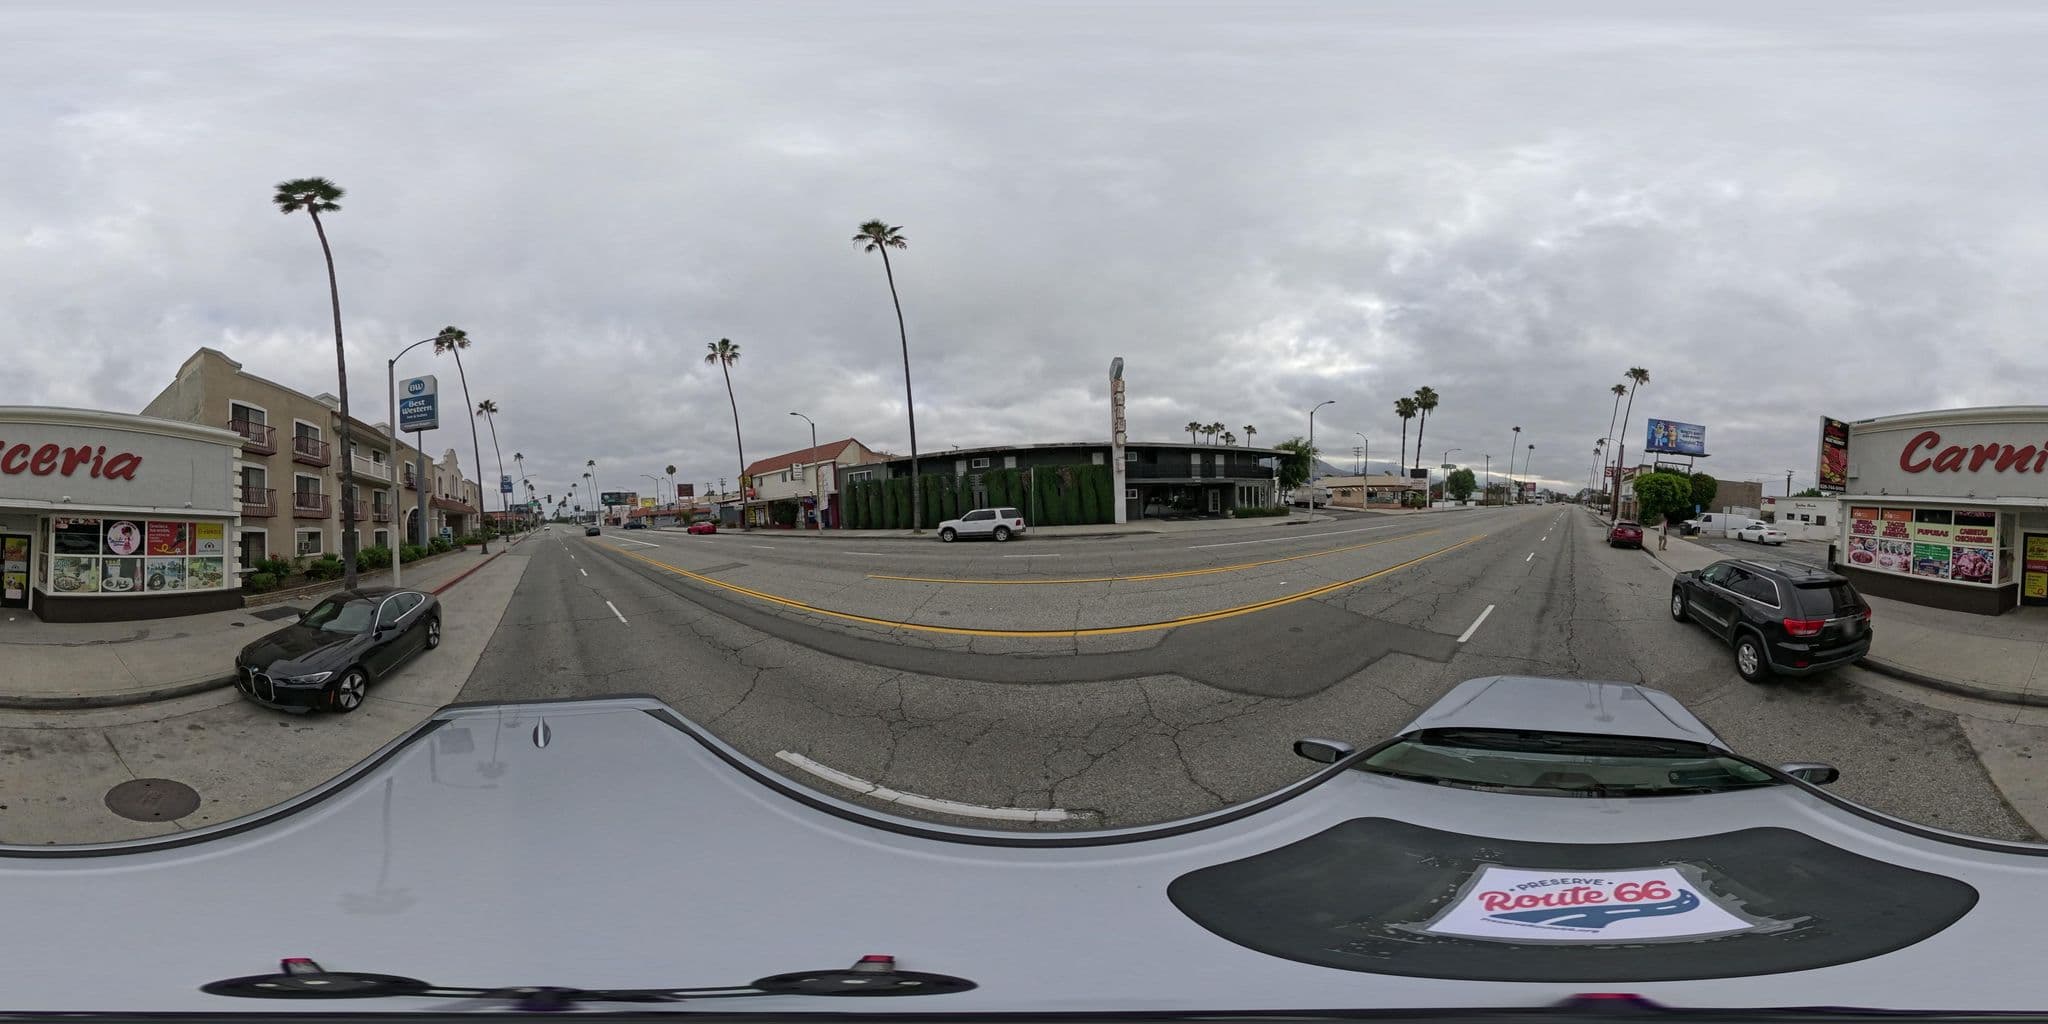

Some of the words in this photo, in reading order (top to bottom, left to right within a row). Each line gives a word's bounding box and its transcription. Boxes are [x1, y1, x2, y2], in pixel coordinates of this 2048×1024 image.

[402, 405, 433, 414] Western
[1917, 528, 1949, 537] PUPUSAS
[1516, 878, 1605, 891] PRESERVE
[1478, 886, 1609, 912] Route
[1613, 880, 1672, 903] 66
